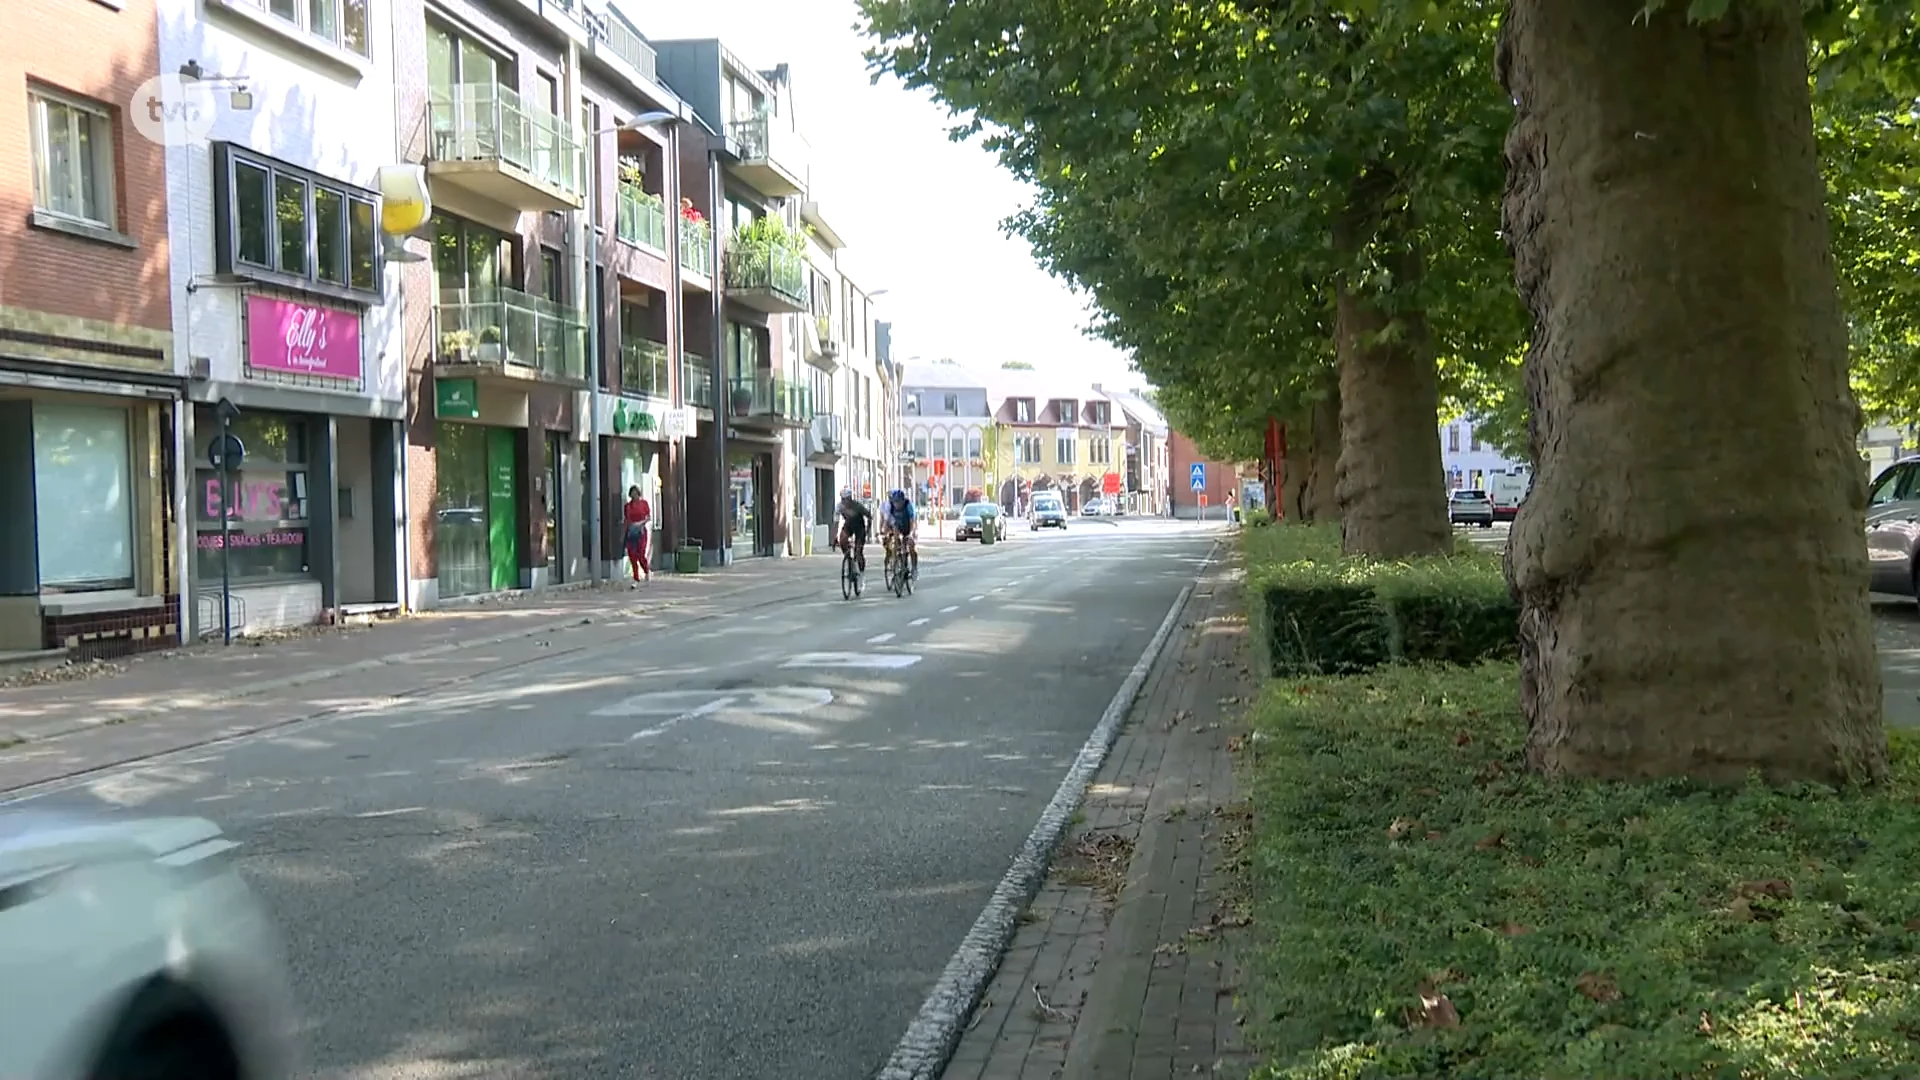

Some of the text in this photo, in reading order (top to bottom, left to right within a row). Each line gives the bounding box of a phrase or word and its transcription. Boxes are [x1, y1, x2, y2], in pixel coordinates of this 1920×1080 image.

[286, 307, 328, 366] Elly's
[206, 479, 282, 517] ELY'S
[229, 533, 261, 547] SNACKS
